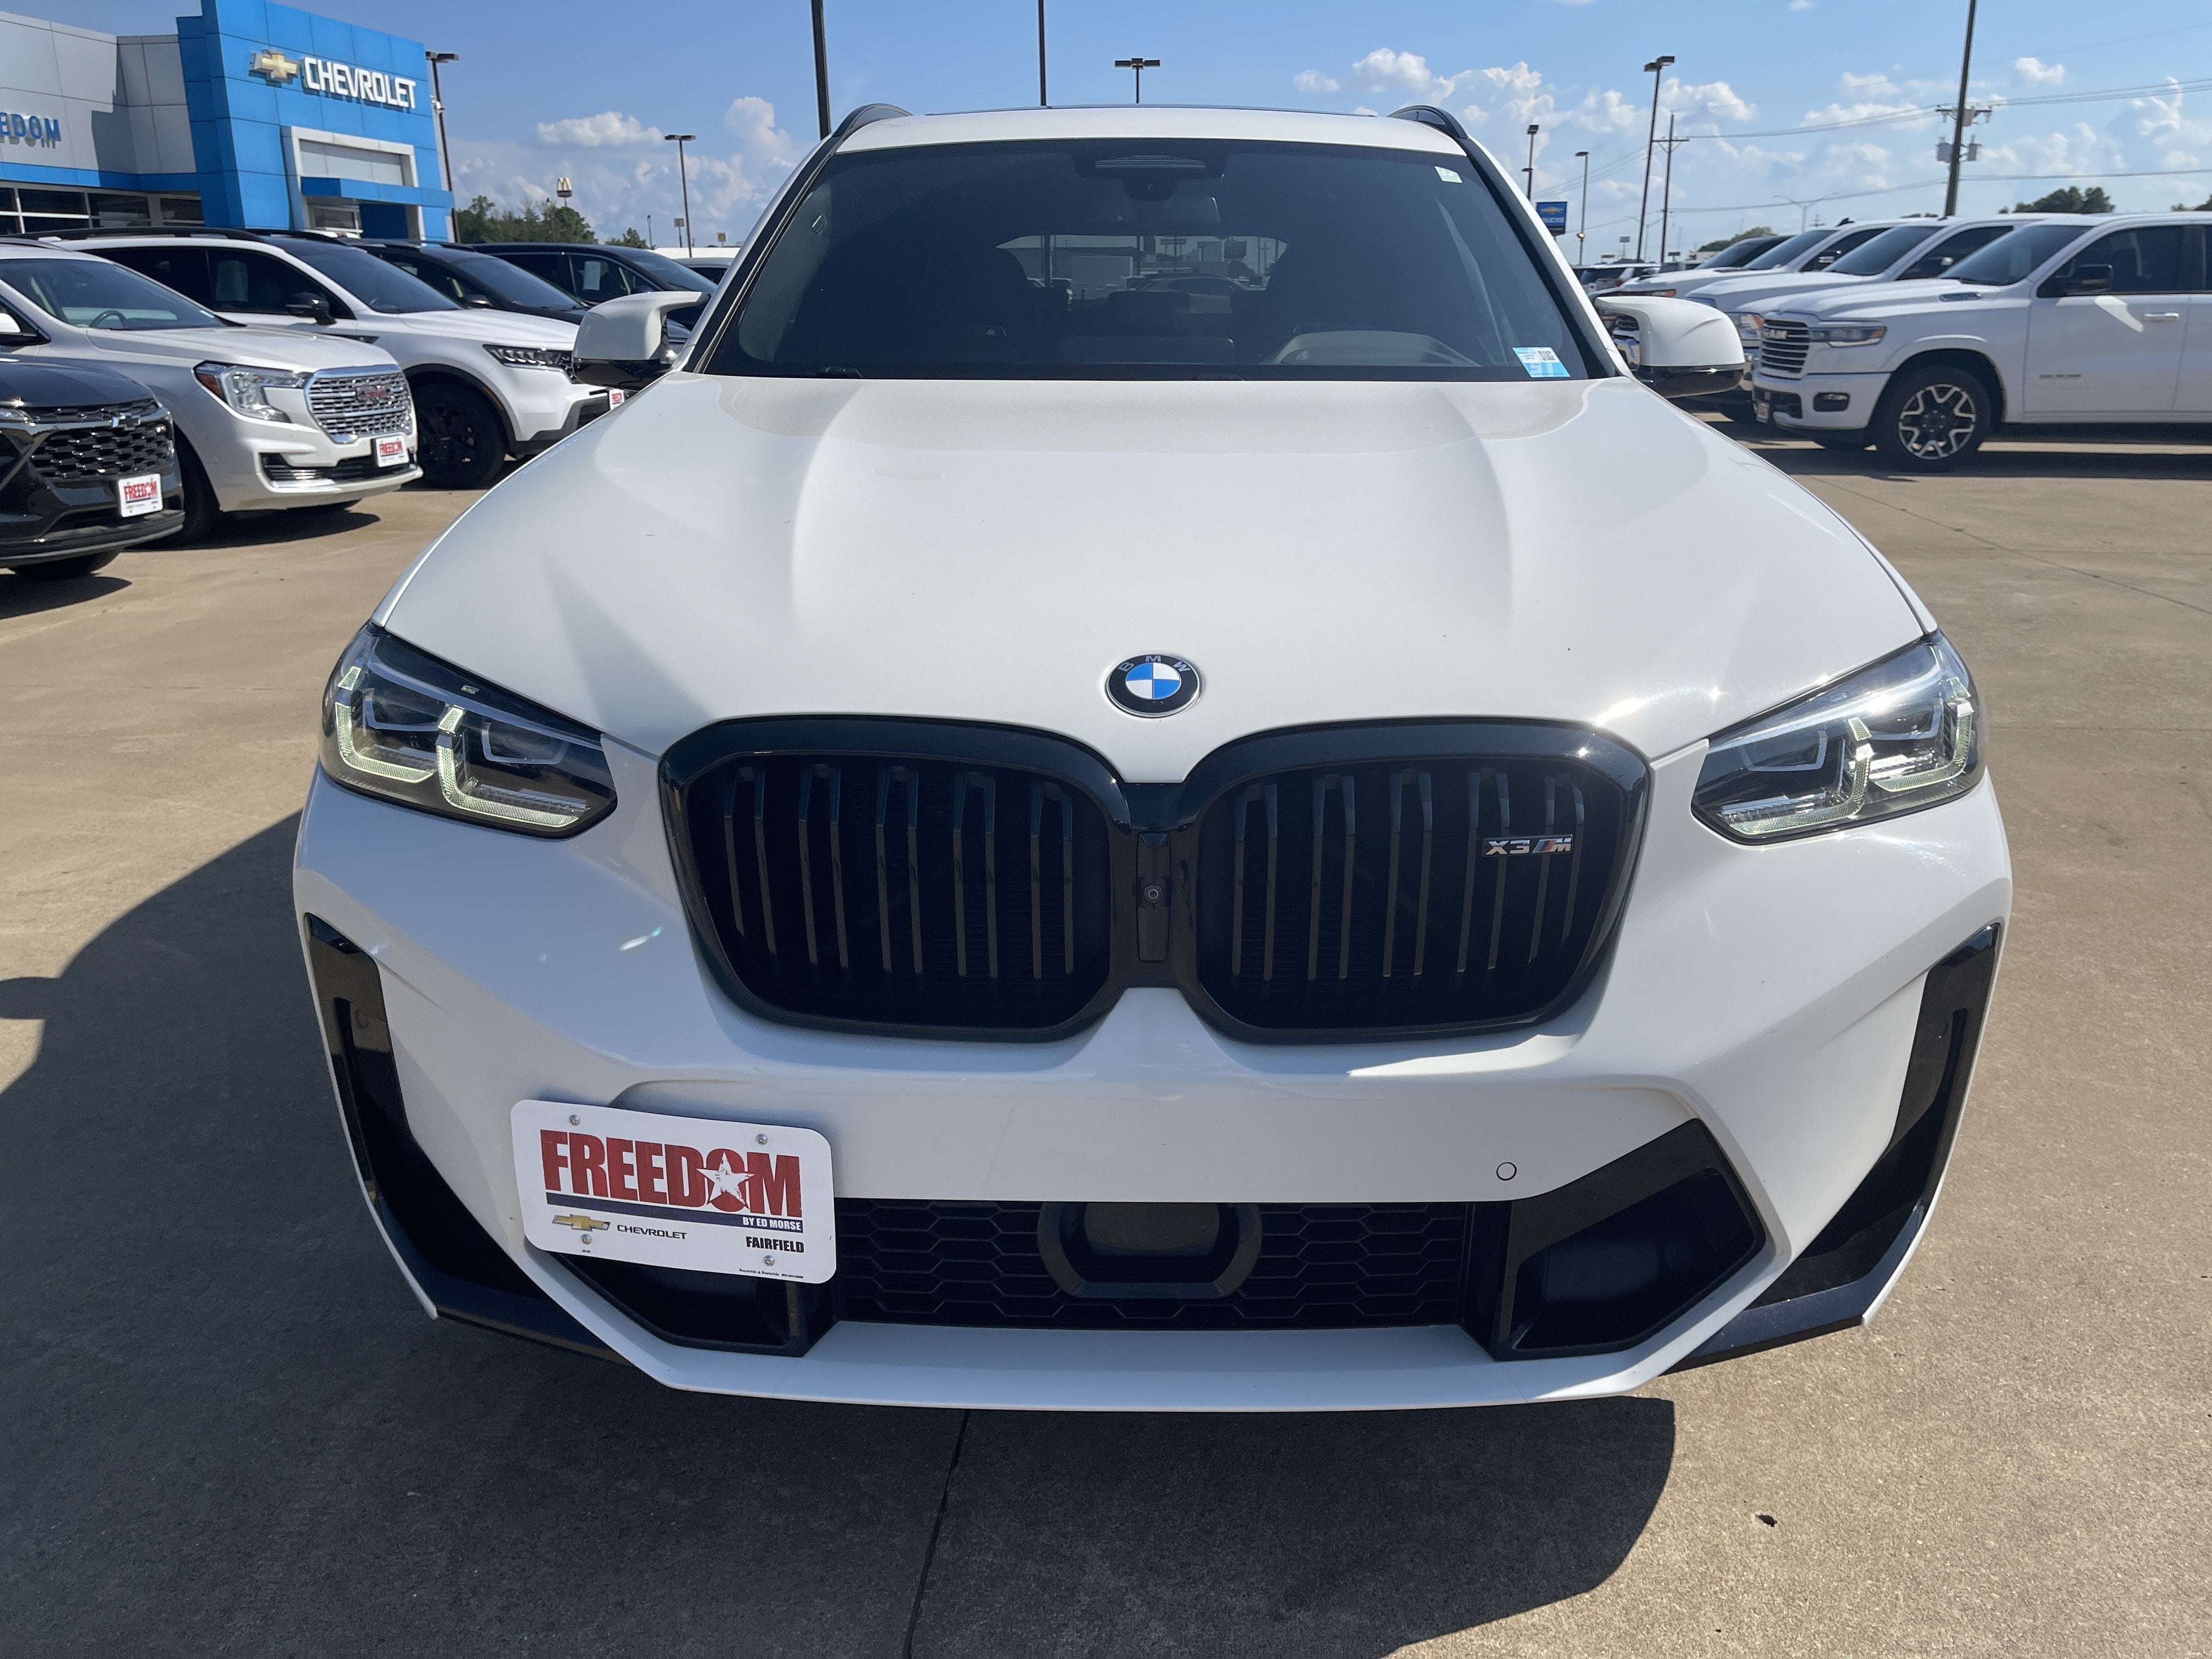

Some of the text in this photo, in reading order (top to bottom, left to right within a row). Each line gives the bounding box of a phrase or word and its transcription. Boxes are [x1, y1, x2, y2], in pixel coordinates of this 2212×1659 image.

[304, 56, 416, 109] CHEVROLET
[124, 482, 157, 500] FREEDOM
[1118, 654, 1192, 673] BMW
[540, 1129, 803, 1218] FREEDOM
[617, 1224, 687, 1239] CHEVROLET
[742, 1216, 802, 1231] BY ED MORSE
[746, 1236, 804, 1253] FAIRFIELD
